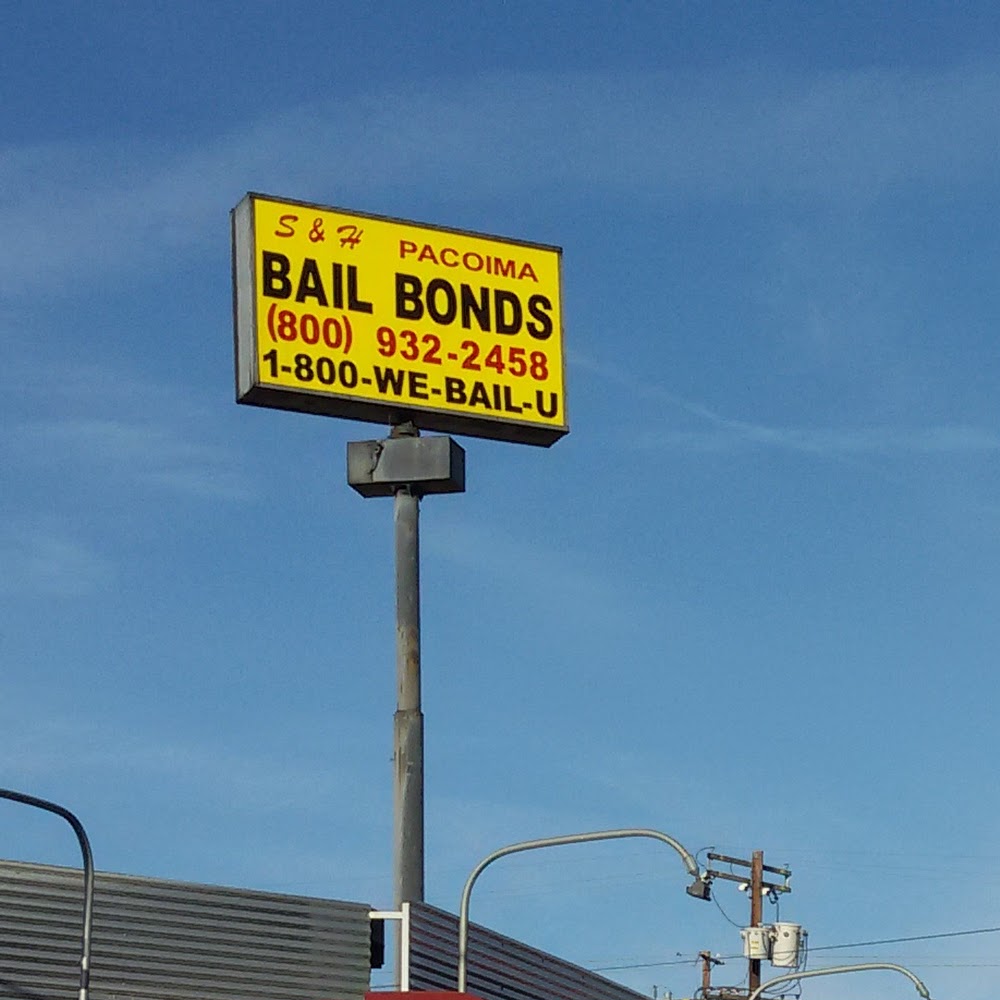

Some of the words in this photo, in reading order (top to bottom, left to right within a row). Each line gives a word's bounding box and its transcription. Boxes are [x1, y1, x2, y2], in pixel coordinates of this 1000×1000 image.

[274, 215, 298, 238] S
[308, 218, 325, 243] &
[336, 225, 364, 249] H
[399, 239, 539, 282] PACOIMA
[262, 250, 373, 314] BAIL
[395, 272, 553, 340] BONDS
[267, 303, 352, 354] (800)
[376, 326, 549, 381] 932-2458
[262, 349, 558, 419] 1-800-WE-BAIL-U
